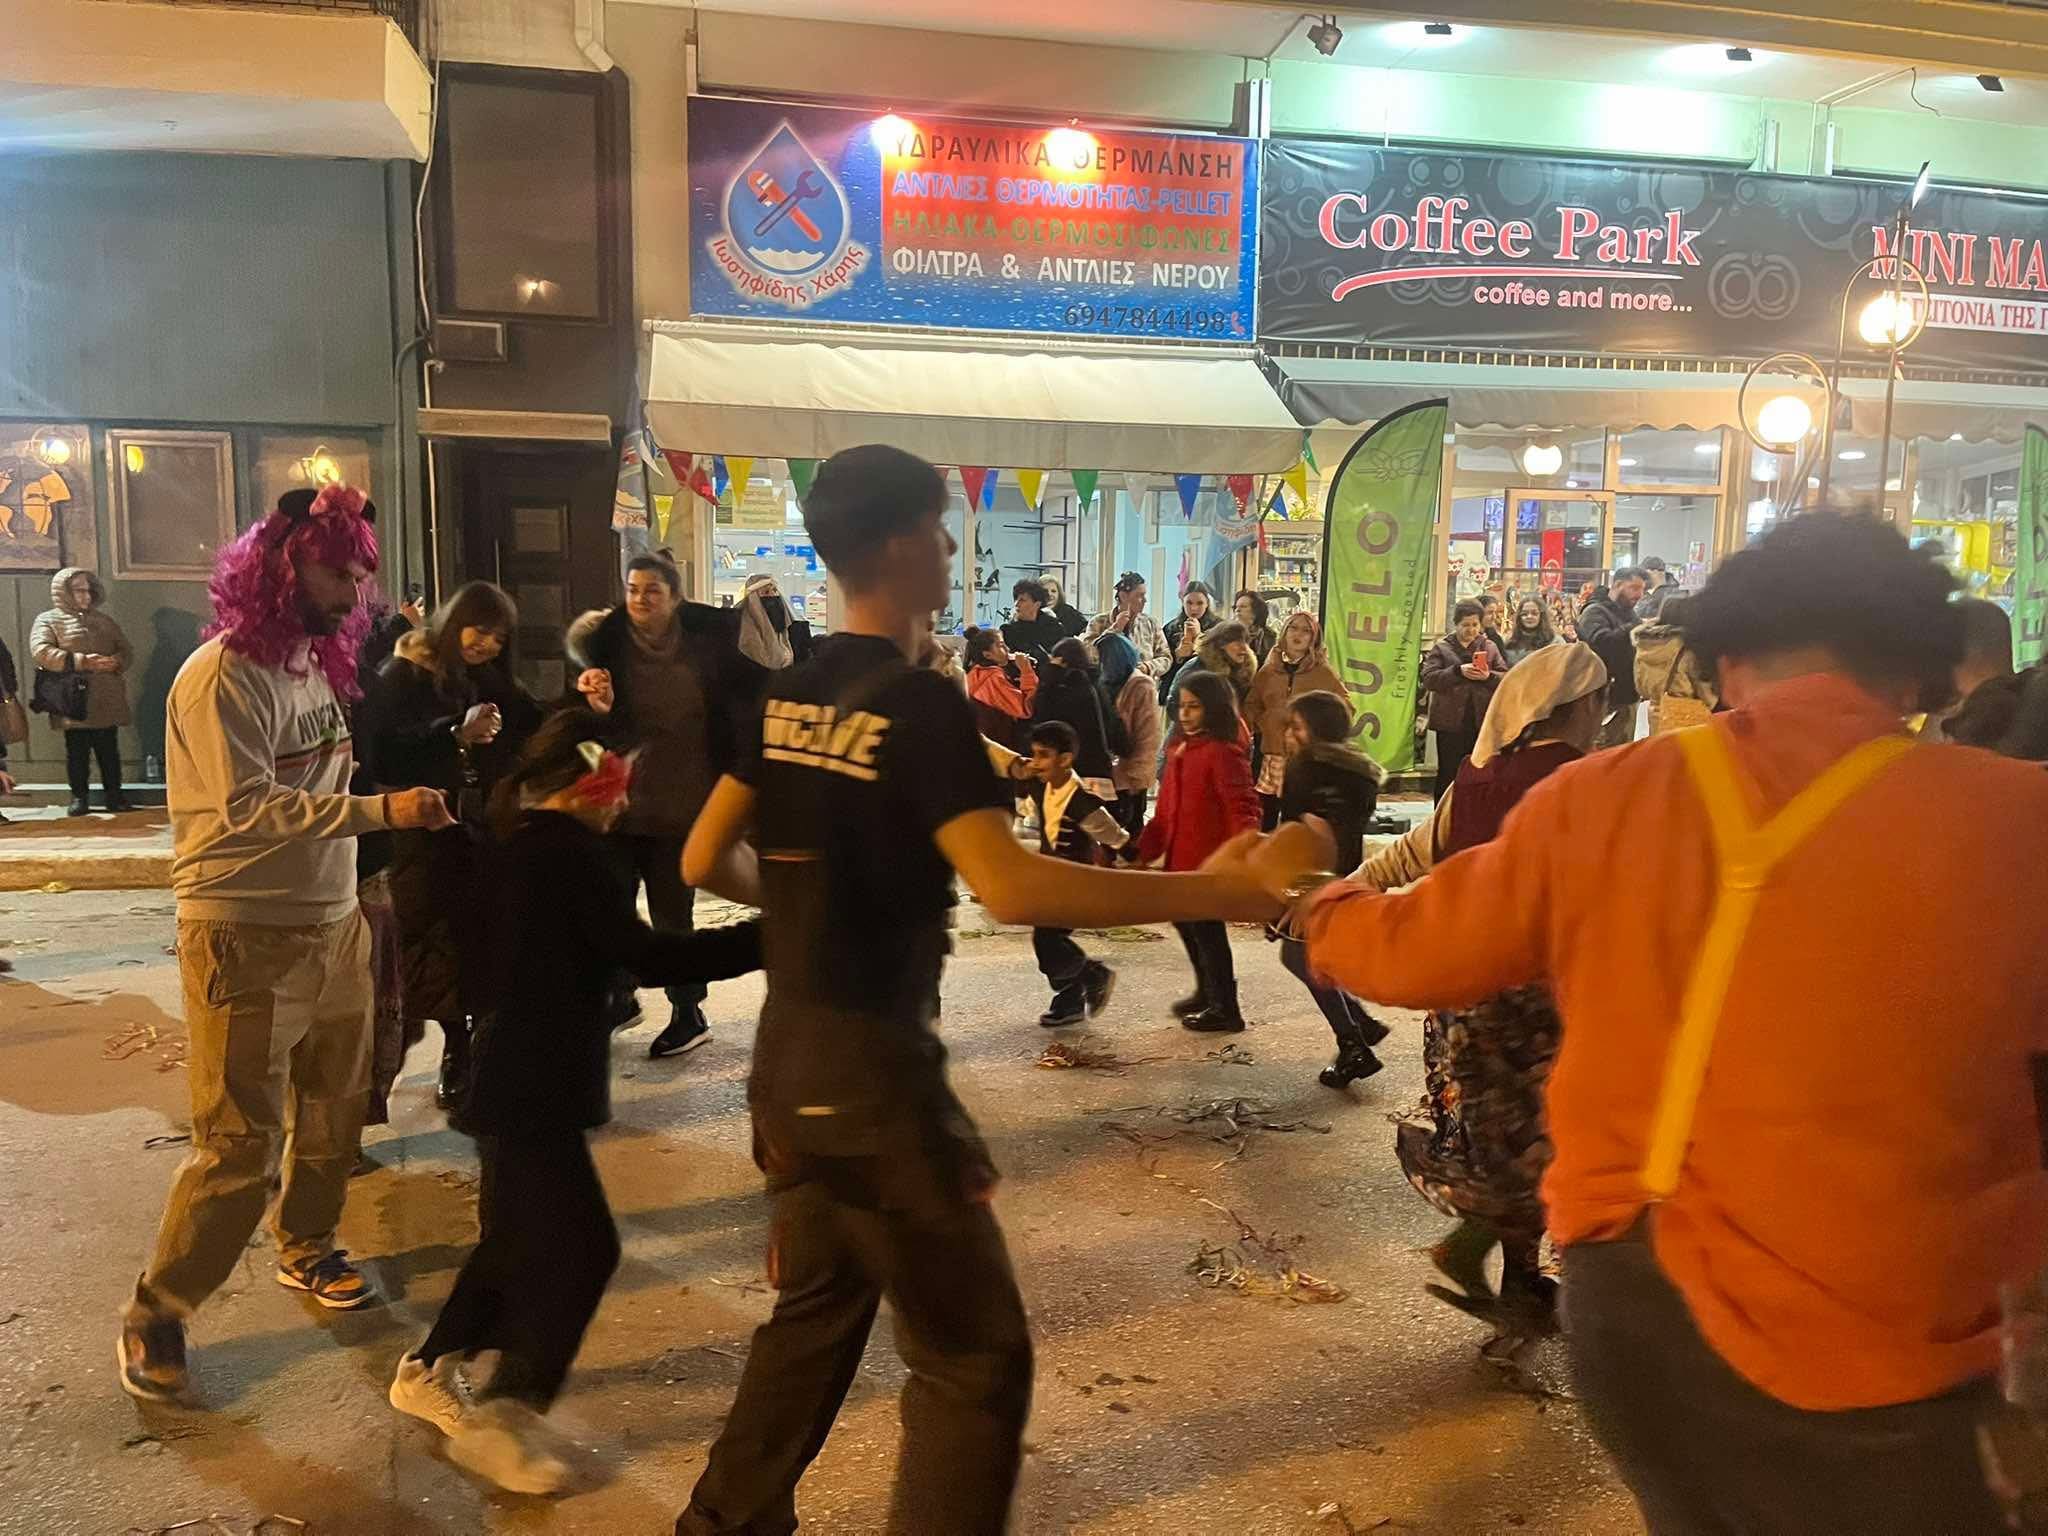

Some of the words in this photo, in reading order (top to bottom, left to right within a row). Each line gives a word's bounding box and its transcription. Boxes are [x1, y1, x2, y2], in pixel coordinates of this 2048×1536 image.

[896, 134, 1050, 166] ΥΔΡΑΥΛΙΚΑ
[892, 172, 988, 200] ΑΝΤΛΙΕΣ
[1318, 194, 1532, 258] Coffee
[1553, 206, 1701, 266] Park
[713, 239, 807, 303] Ιωσηφίδης
[810, 246, 863, 294] Χάρης
[892, 247, 984, 278] ΦΙΛΤΡΑ
[1001, 253, 1021, 279] &
[1037, 256, 1136, 285] ΑΝΤΛΙΕΣ
[1152, 262, 1230, 290] ΝΕΡΟΥ
[1869, 225, 1977, 287] MINI
[1474, 283, 1550, 306] coffee
[1557, 287, 1602, 309] and
[1610, 292, 1693, 313] more...
[1064, 304, 1225, 332] 6947844498
[2000, 305, 2036, 329] ΤΗΣ
[1344, 511, 1400, 740] SUELO
